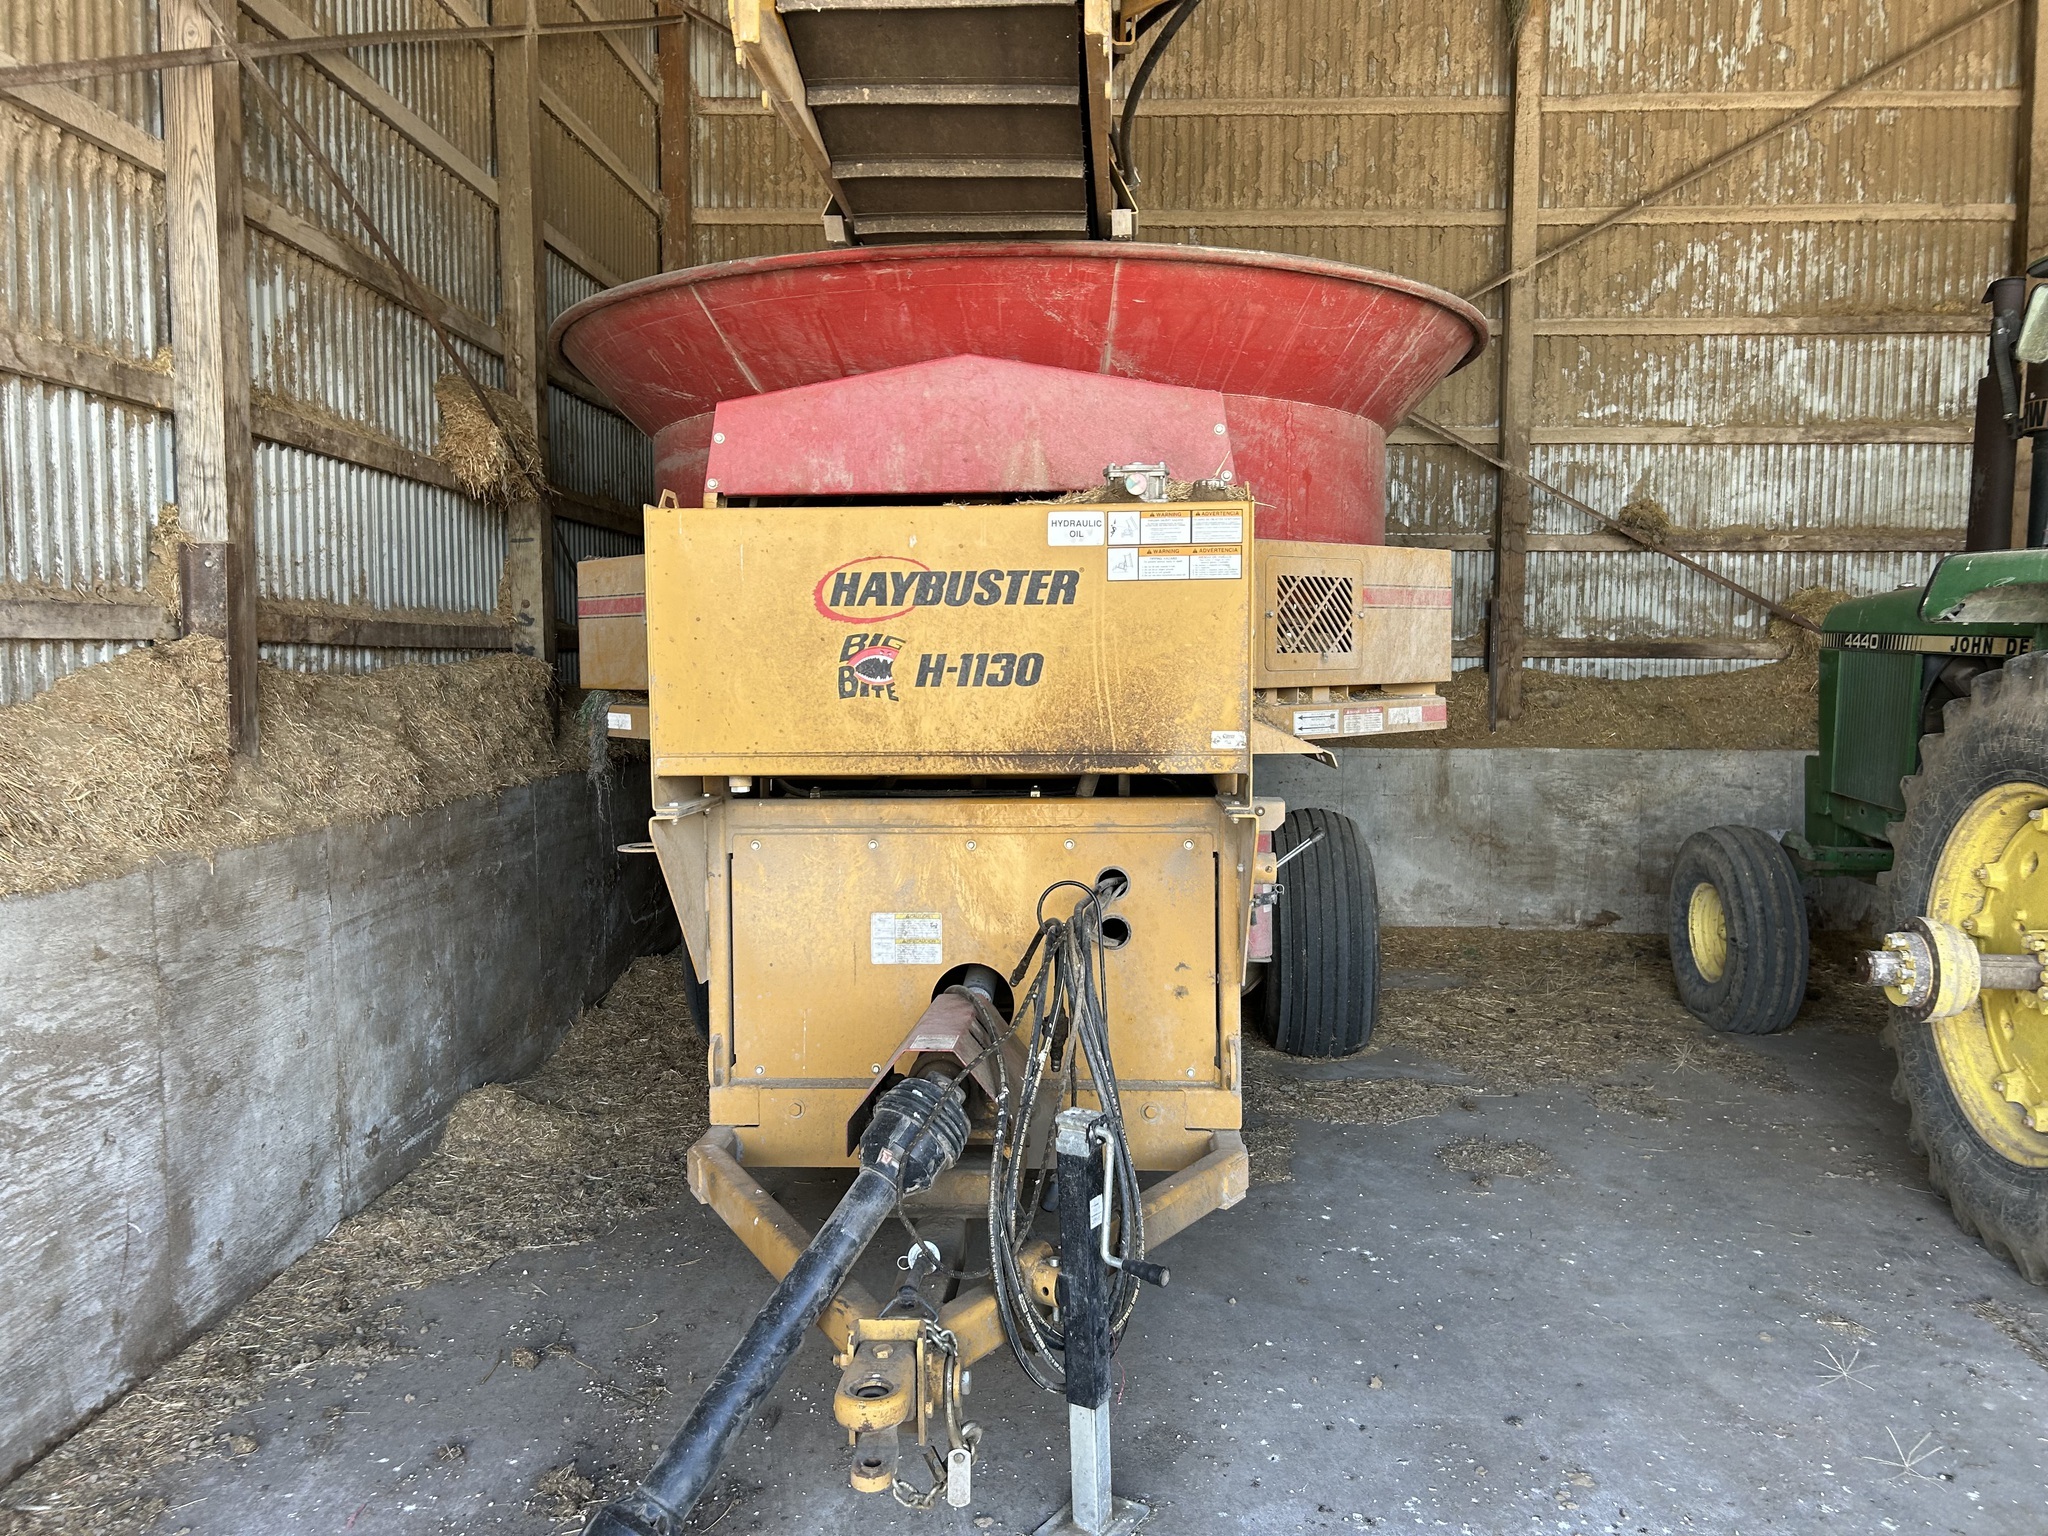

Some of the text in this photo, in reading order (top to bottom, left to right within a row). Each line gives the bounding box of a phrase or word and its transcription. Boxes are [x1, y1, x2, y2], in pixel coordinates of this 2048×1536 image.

[1051, 519, 1102, 528] HYDRAULIC
[1069, 530, 1084, 538] OIL
[829, 569, 1080, 607] HAYBUSTER
[840, 632, 907, 663] BIG
[1844, 633, 1879, 650] 4440
[1950, 636, 1994, 654] JOHN
[915, 652, 1045, 688] H-1130
[838, 664, 900, 702] BITE
